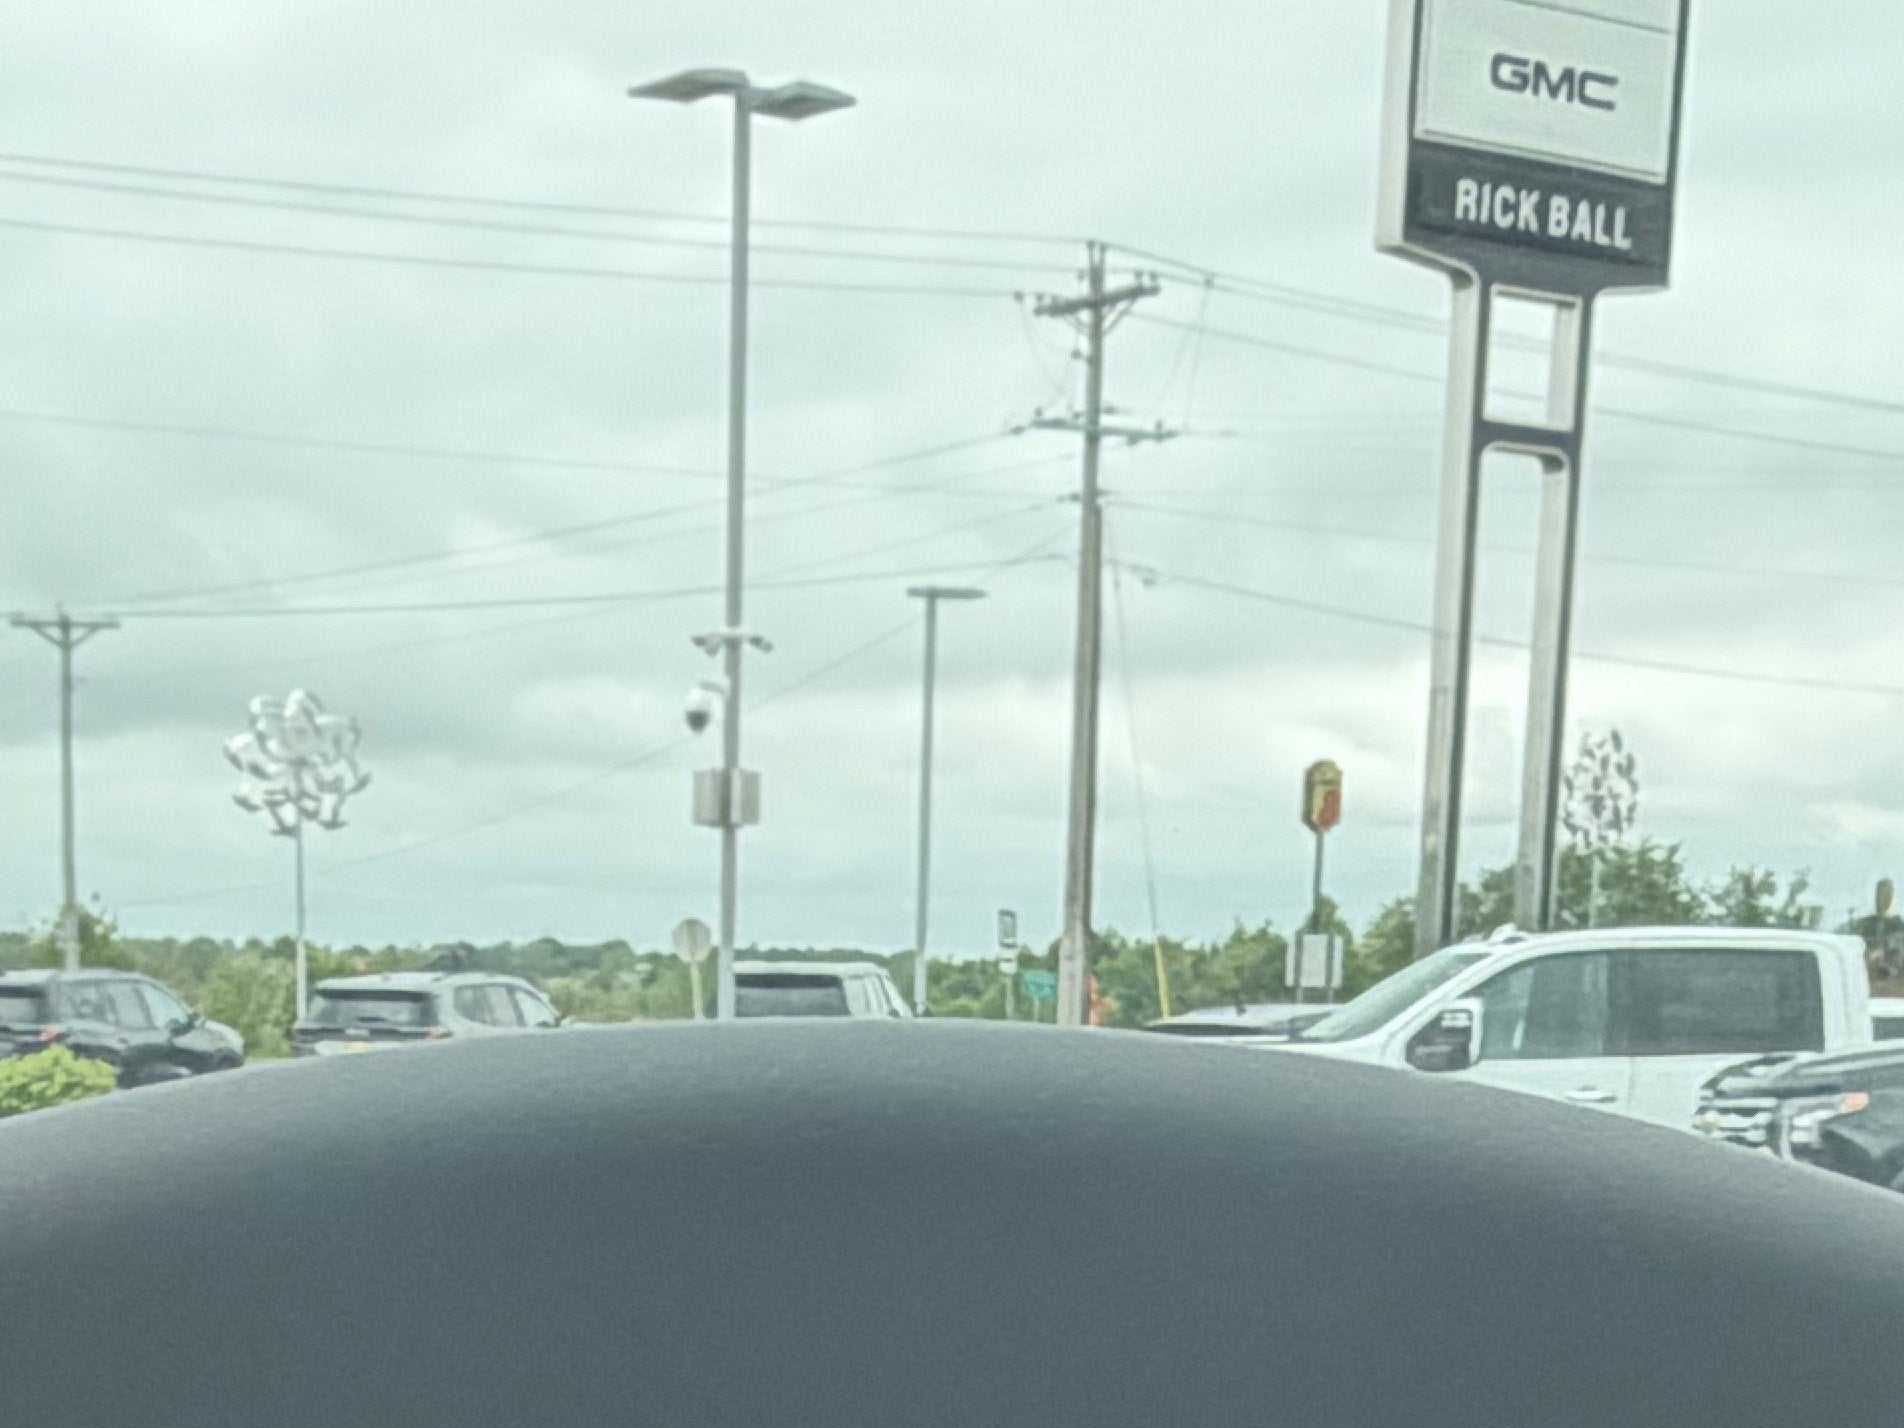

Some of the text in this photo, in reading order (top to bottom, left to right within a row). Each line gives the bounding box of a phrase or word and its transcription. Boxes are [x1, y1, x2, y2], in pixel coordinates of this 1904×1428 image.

[1491, 53, 1619, 111] GMC
[1454, 177, 1634, 251] RICK BALL
